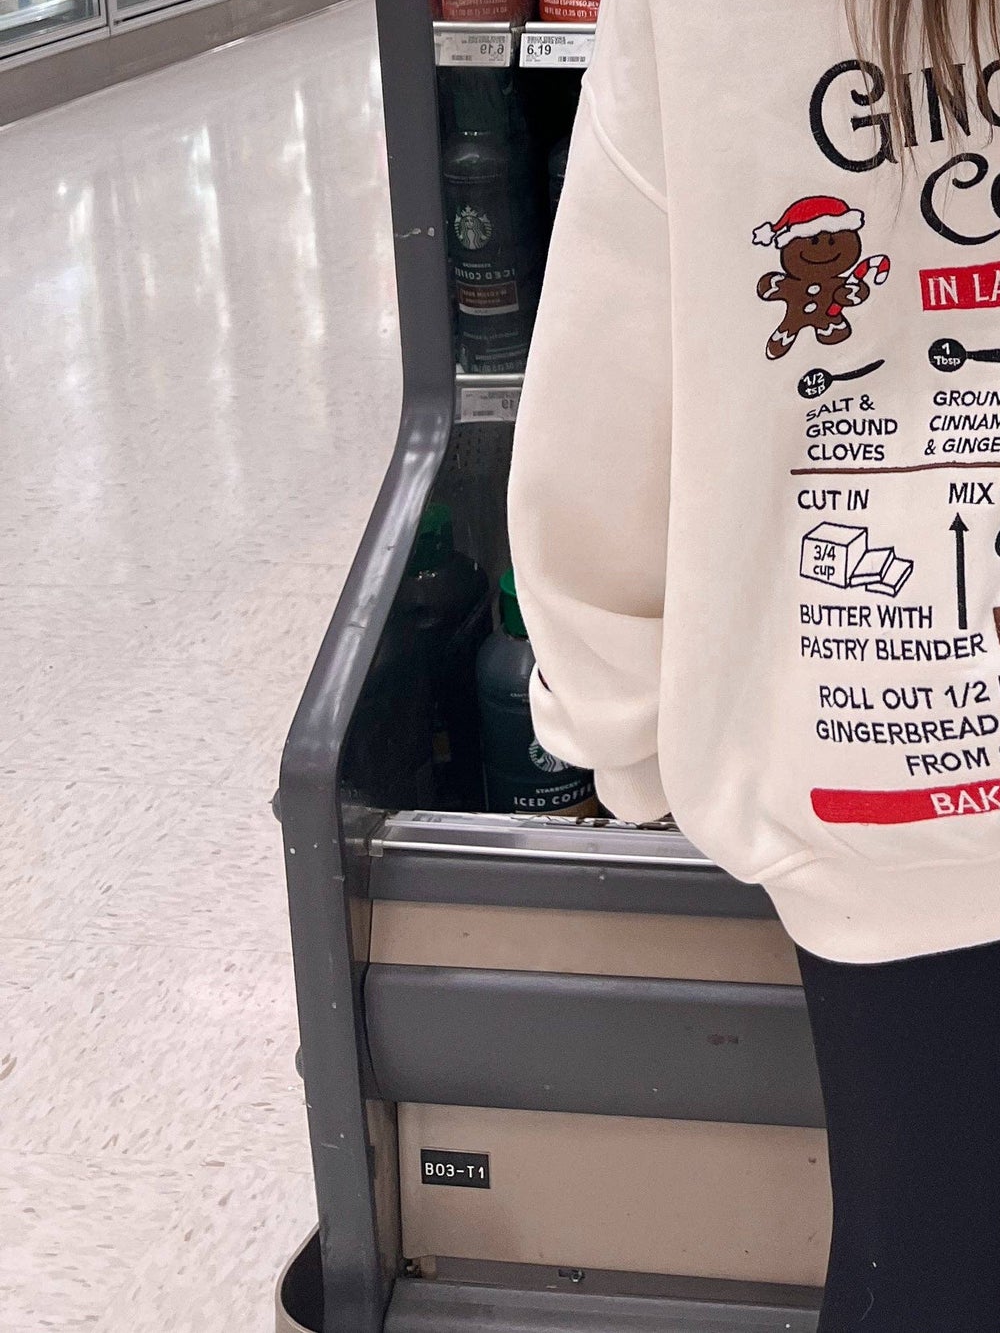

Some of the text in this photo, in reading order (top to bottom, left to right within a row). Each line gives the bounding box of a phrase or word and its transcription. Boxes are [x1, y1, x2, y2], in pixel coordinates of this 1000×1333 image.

[527, 44, 551, 55] 6.19
[928, 274, 959, 306] IN
[942, 342, 950, 355] 1
[934, 354, 961, 367] Tbsp
[803, 371, 825, 387] 1/2
[805, 383, 825, 396] tsp
[806, 394, 875, 422] SALT &
[806, 418, 898, 438] GROUND
[807, 443, 885, 462] CLOVES
[924, 439, 936, 456] &
[797, 488, 869, 511] CUT IN
[949, 482, 995, 505] MIX
[813, 545, 836, 562] 3/4
[813, 562, 836, 580] cup
[800, 604, 933, 629] BUTTER WITH
[801, 633, 987, 662] PASTRY BLENDER
[819, 685, 874, 710] ROLL
[882, 687, 933, 710] OUT
[944, 680, 990, 708] 1/2
[816, 713, 999, 745] GINGERBREAD
[905, 746, 991, 777] FROM
[514, 796, 546, 808] ICED
[424, 1162, 485, 1179] B03-T1
